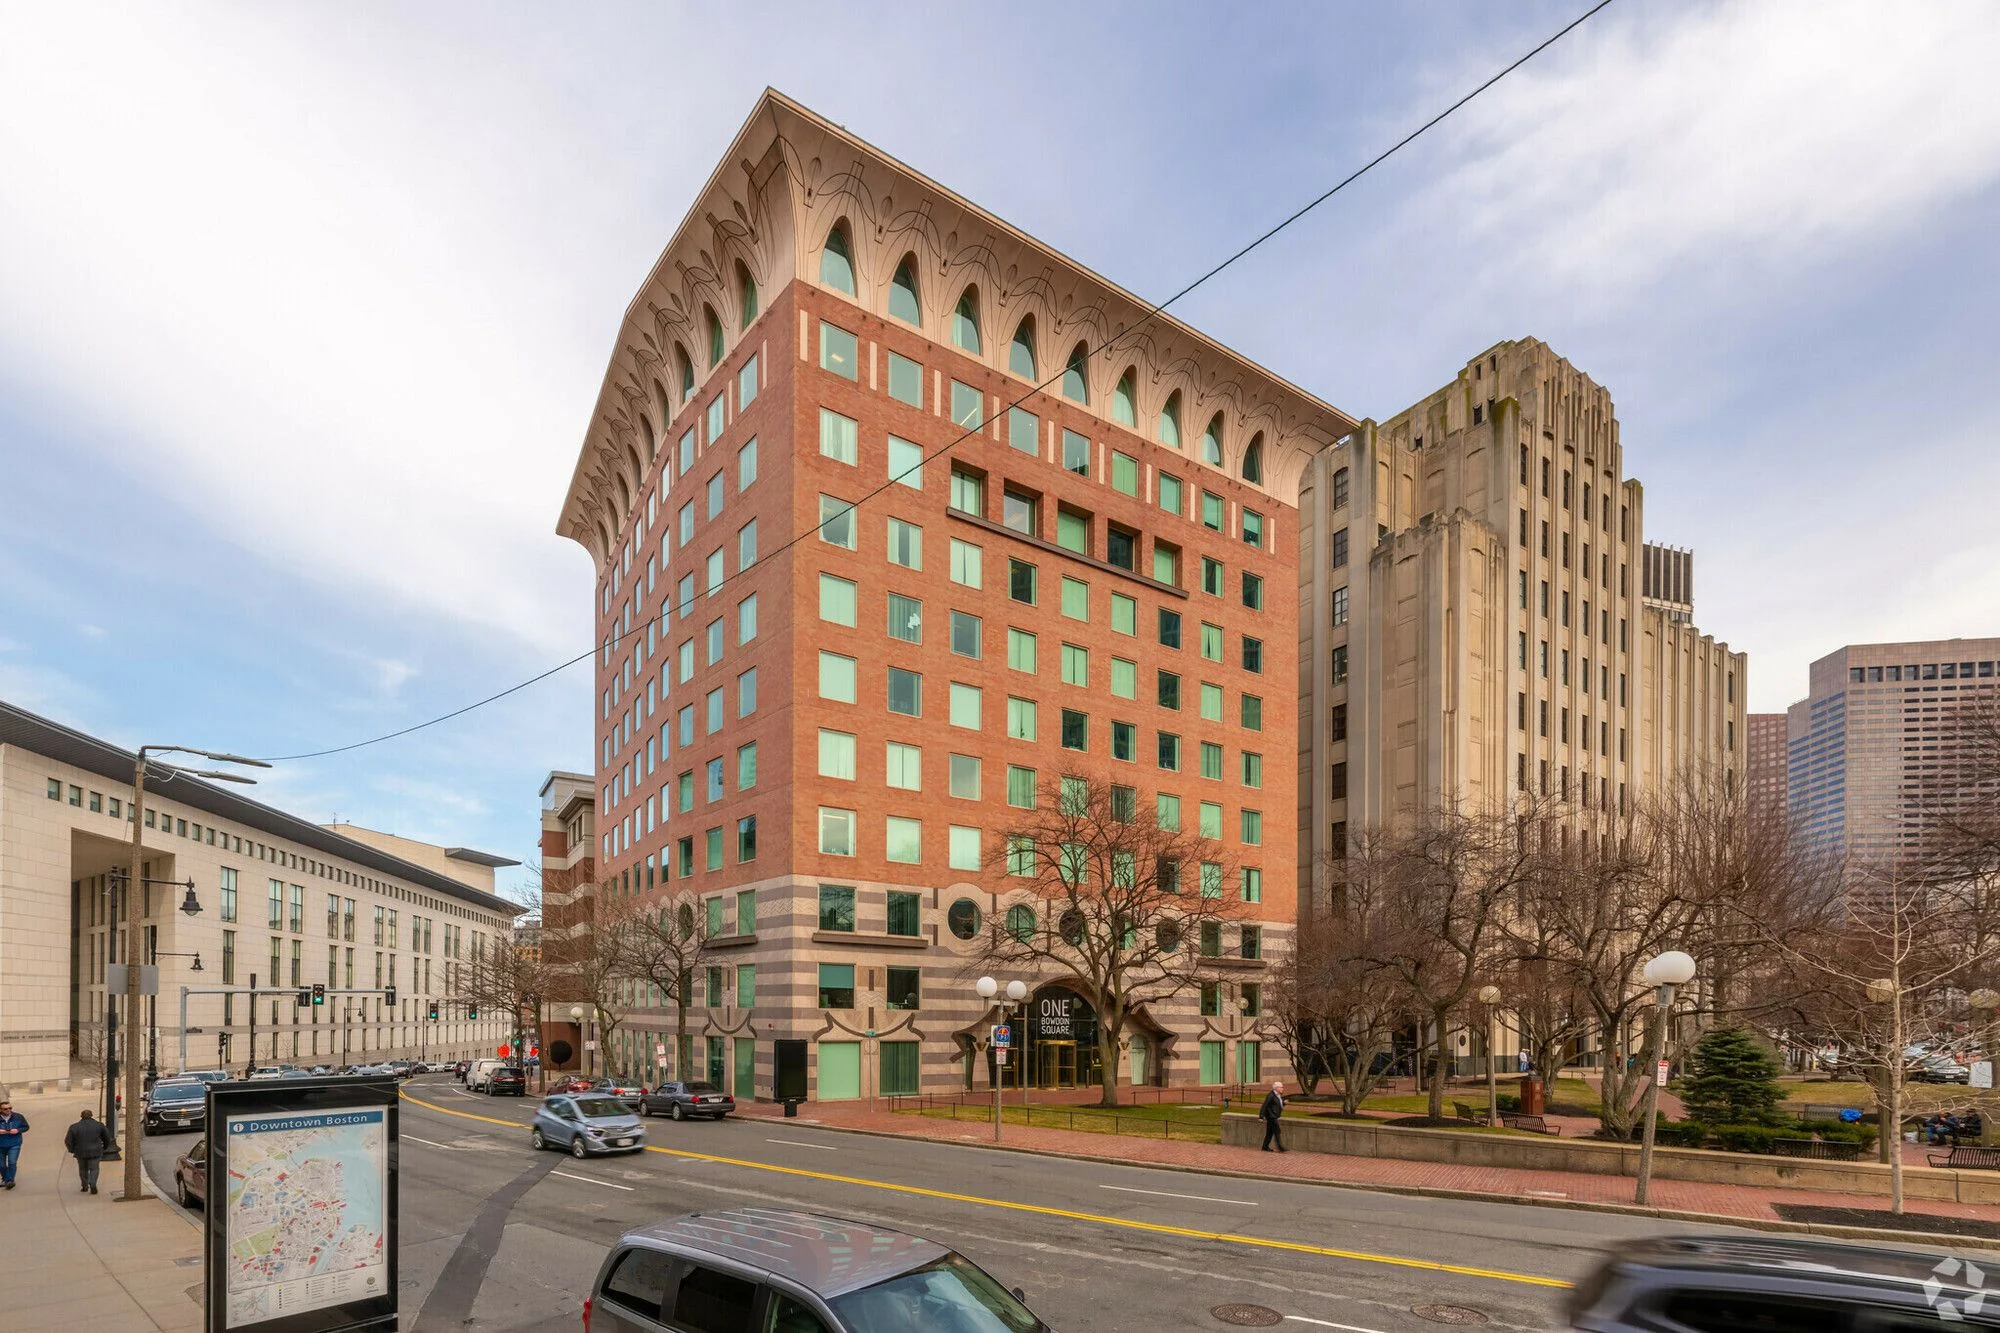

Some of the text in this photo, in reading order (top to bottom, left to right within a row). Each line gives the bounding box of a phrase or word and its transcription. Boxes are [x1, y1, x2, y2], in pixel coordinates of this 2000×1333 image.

[1041, 999, 1070, 1017] ONE
[1041, 1017, 1070, 1026] BOWDOIN
[1041, 1025, 1070, 1035] SQUARE
[250, 1115, 368, 1132] Downtown Boston
